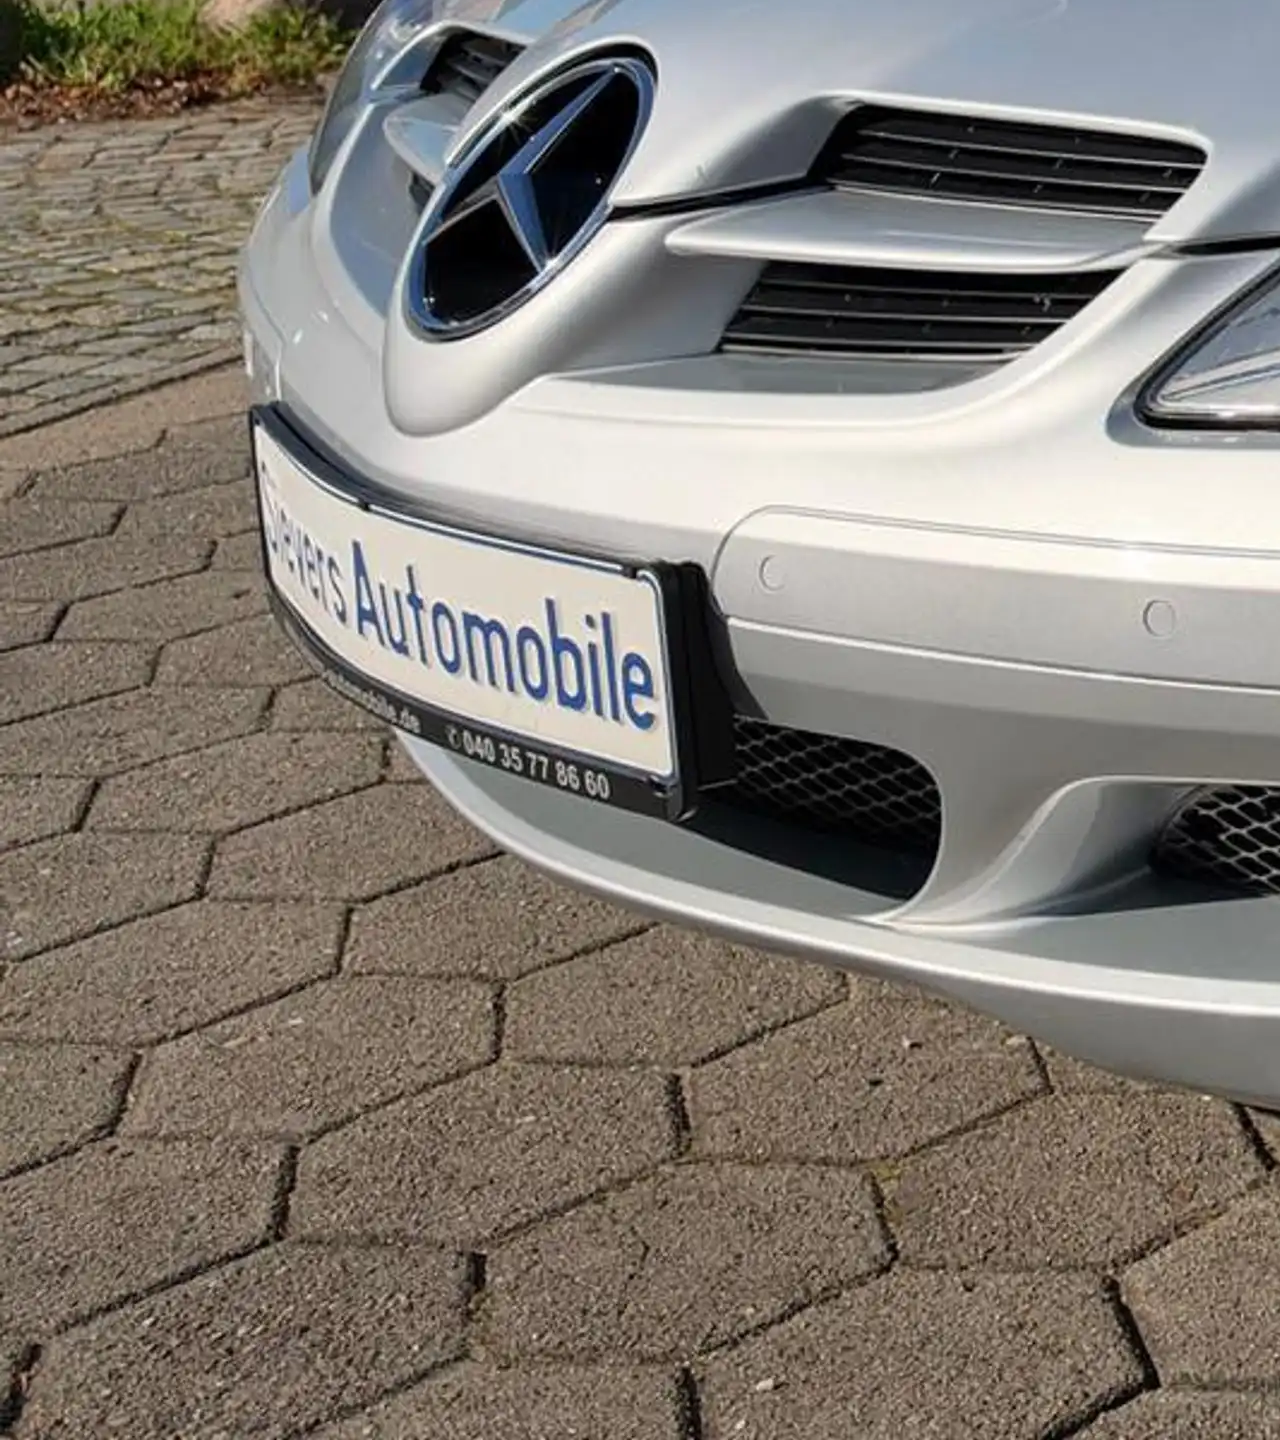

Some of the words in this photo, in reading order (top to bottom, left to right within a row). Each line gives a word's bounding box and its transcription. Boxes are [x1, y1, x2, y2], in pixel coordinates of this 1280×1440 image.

[350, 539, 657, 731] Automobile
[463, 729, 496, 764] 040
[499, 743, 524, 773] 35
[525, 751, 549, 781] 77
[555, 759, 580, 791] 86
[584, 769, 612, 800] 60
